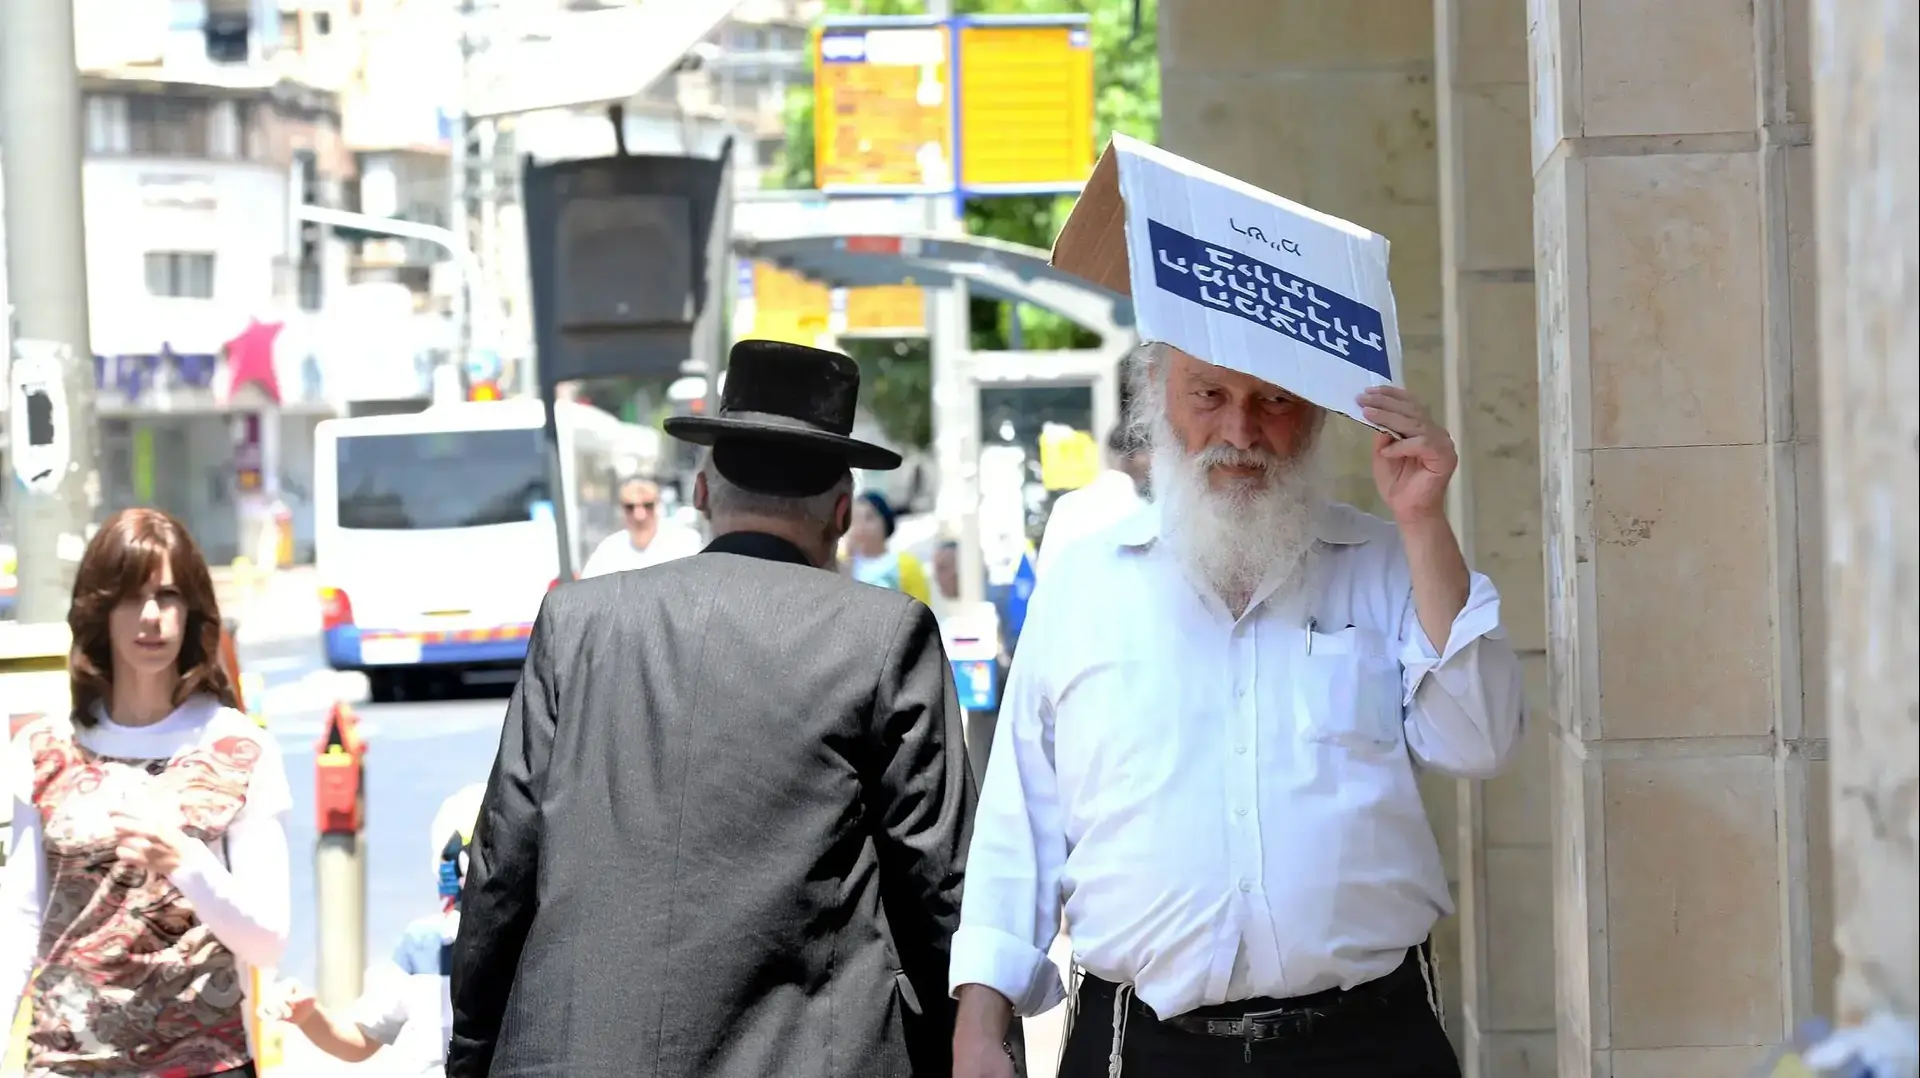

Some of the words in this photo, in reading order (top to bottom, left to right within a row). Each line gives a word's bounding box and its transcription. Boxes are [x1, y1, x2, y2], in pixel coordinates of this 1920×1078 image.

[1159, 249, 1383, 351] המהודרות
[1205, 247, 1331, 309] ביותר
[1200, 286, 1350, 356] המצות
